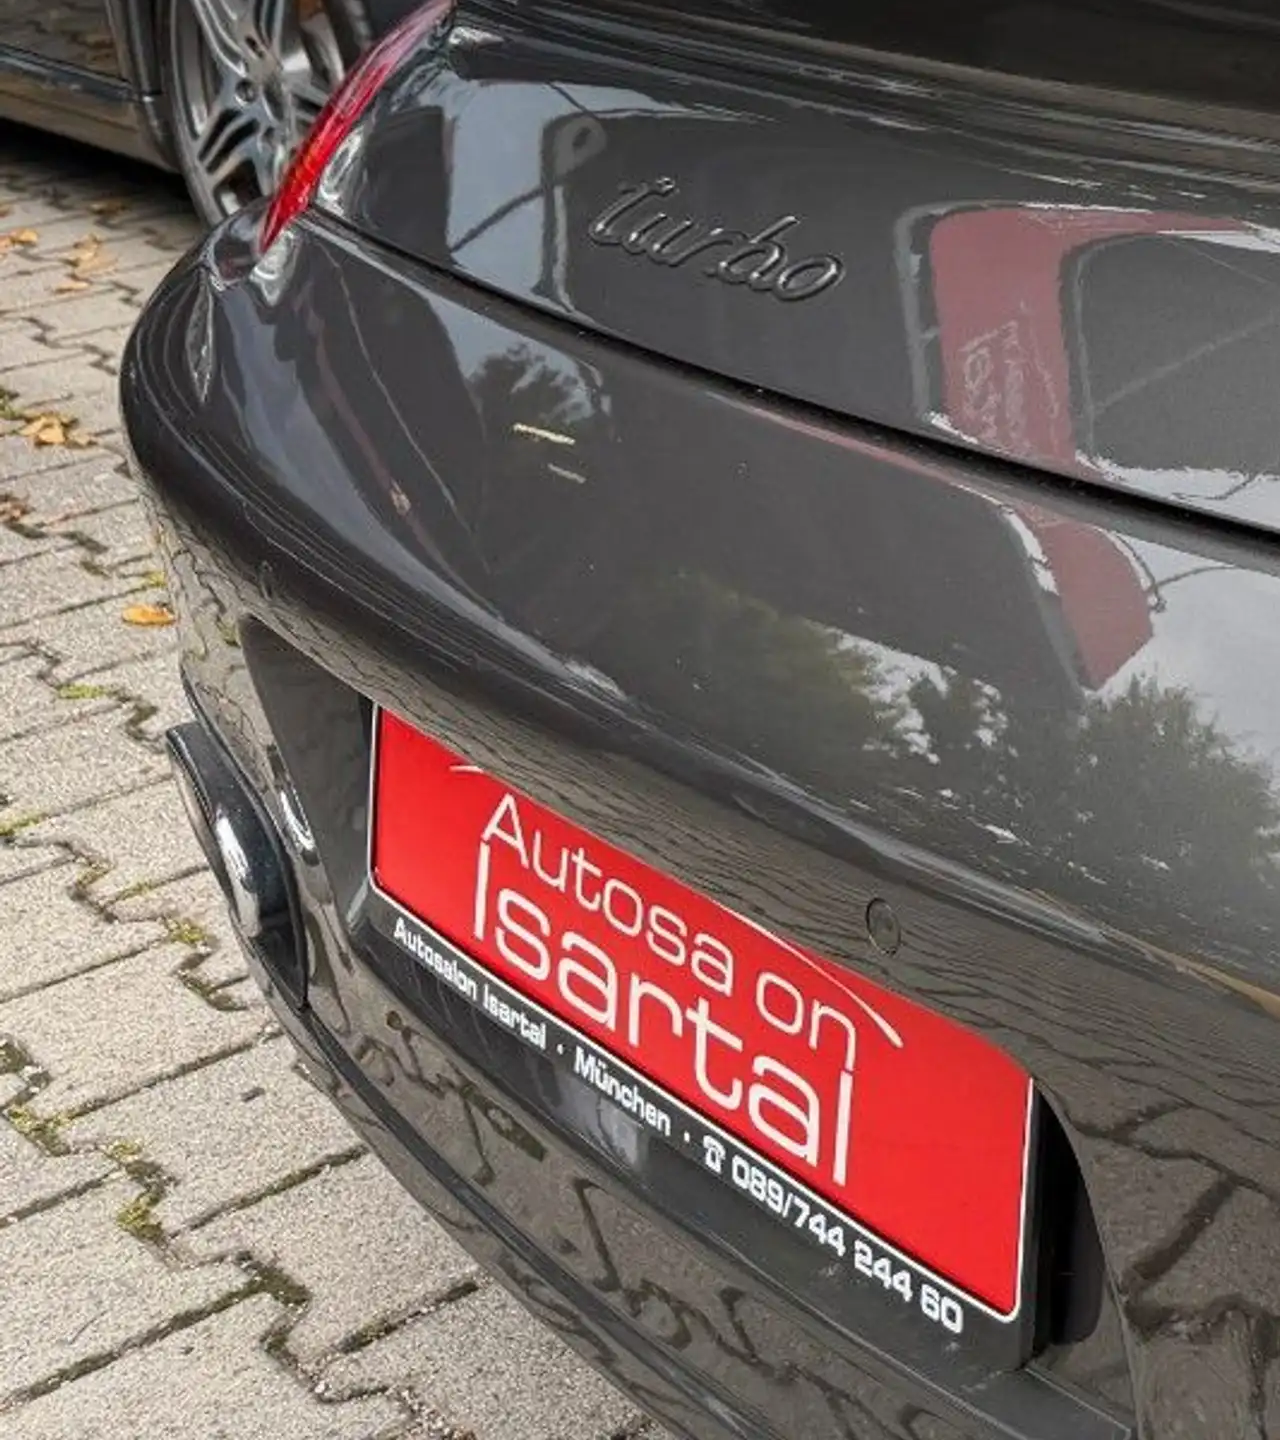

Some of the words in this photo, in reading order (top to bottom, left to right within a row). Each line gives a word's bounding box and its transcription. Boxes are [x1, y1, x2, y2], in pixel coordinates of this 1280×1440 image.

[588, 176, 847, 302] turbo
[393, 916, 478, 1001] Autosalon
[482, 983, 548, 1051] Isartal
[573, 1045, 672, 1137] München
[731, 1155, 847, 1257] 089/744
[853, 1239, 914, 1303] 244
[920, 1283, 964, 1334] 60
[473, 841, 855, 1187] Isartal
